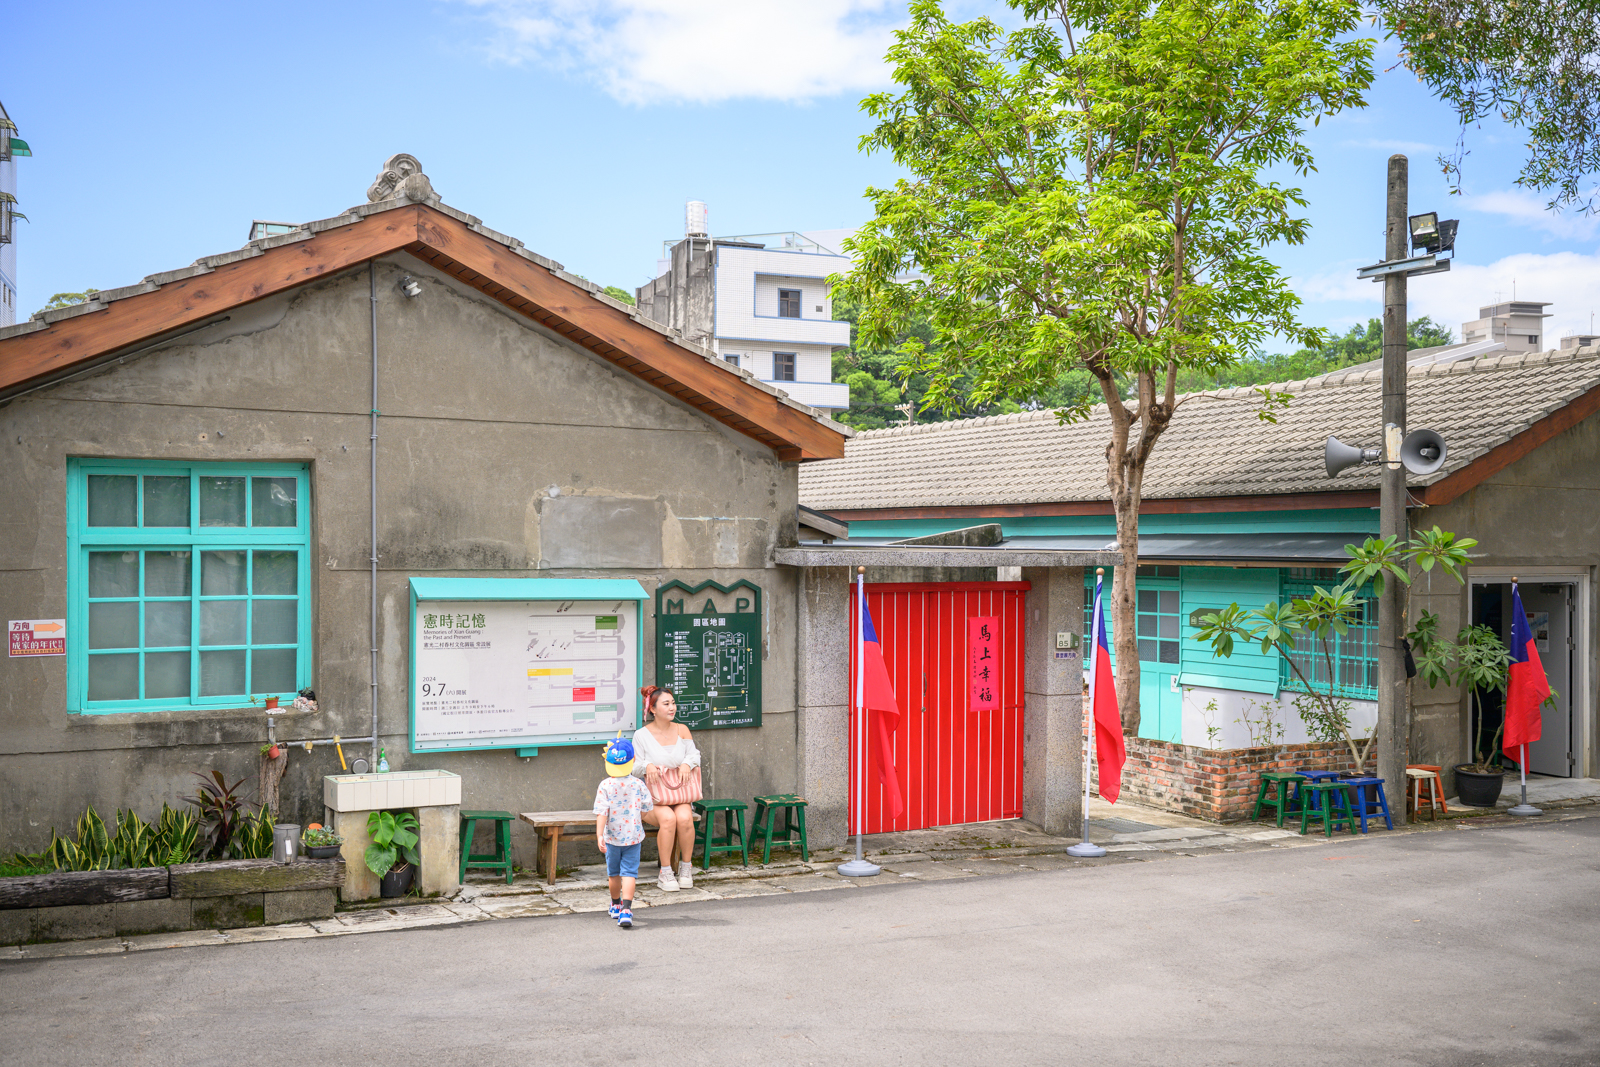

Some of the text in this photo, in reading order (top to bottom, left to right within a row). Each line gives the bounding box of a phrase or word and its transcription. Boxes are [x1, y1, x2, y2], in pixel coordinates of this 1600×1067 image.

[667, 597, 750, 614] MAP
[13, 622, 30, 631] 方向
[423, 613, 486, 629] 憲時記憶
[12, 633, 30, 641] 等待
[979, 624, 992, 702] 馬上幸福
[422, 683, 446, 697] 9.7
